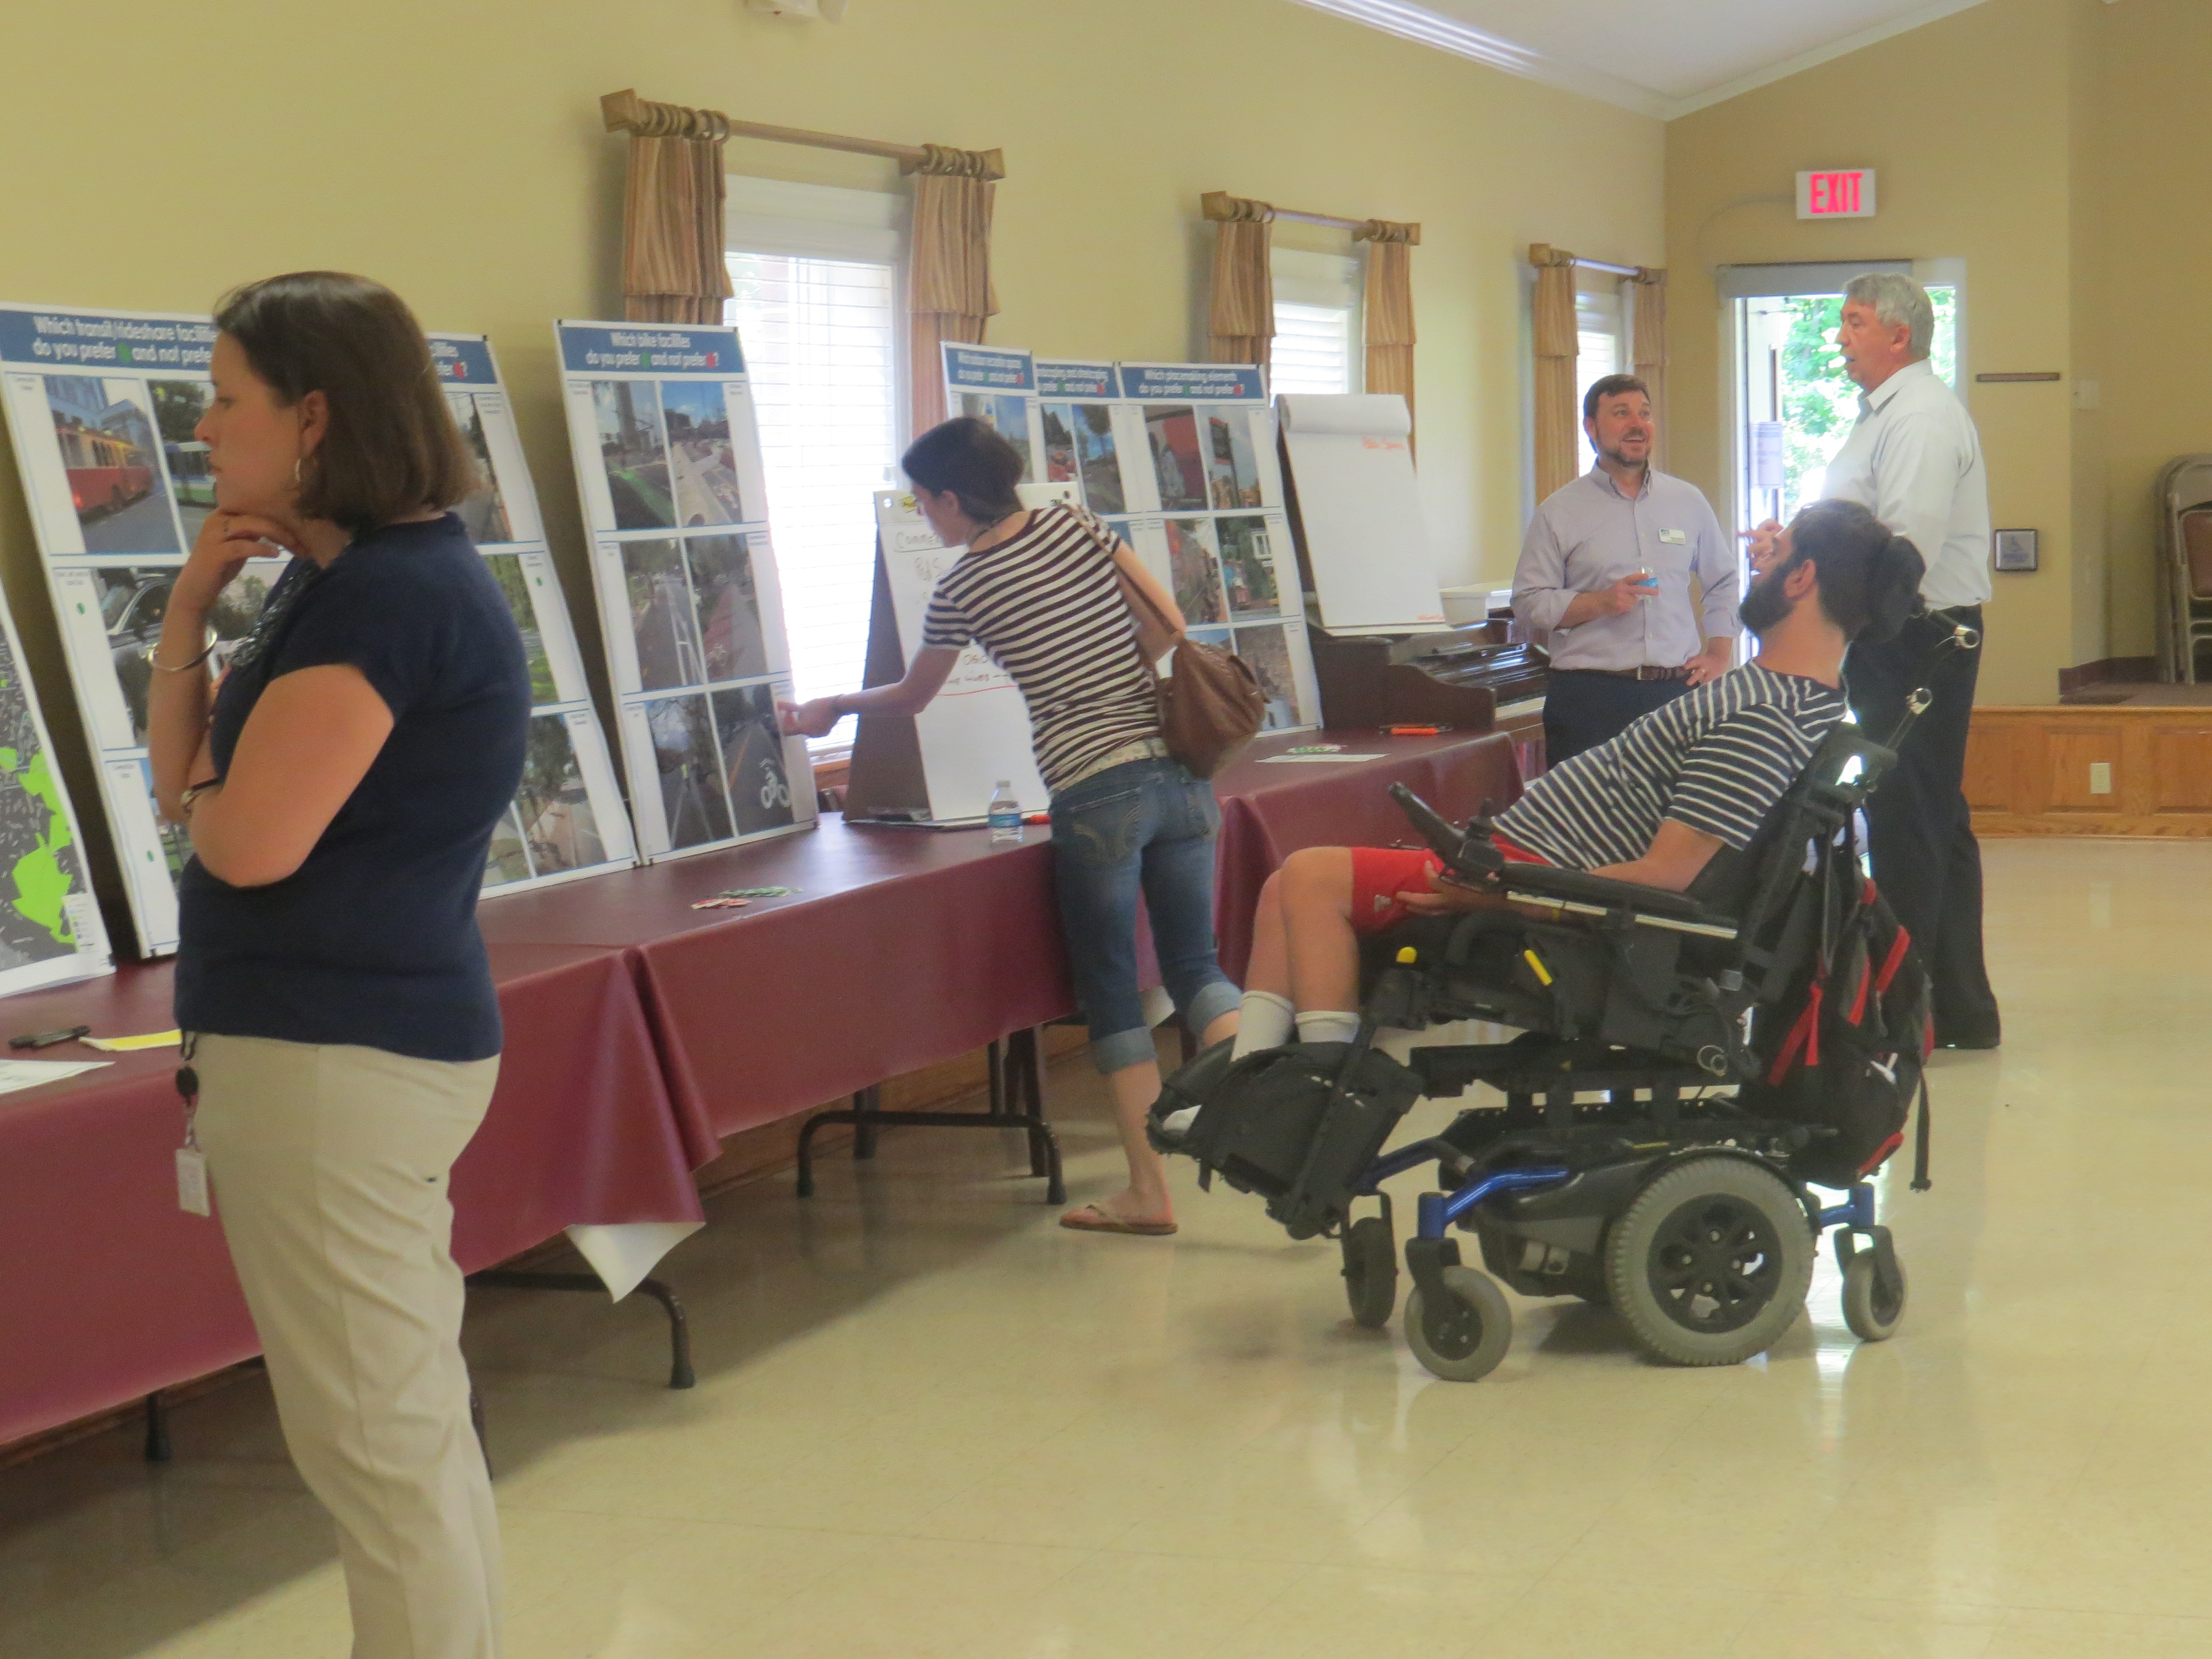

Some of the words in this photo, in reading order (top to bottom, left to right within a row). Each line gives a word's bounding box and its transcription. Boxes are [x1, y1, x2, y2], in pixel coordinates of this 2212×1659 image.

[1809, 172, 1863, 213] EXIT
[33, 316, 76, 335] Which
[175, 323, 217, 343] facilitie
[611, 332, 636, 347] Which
[637, 332, 658, 348] bike
[658, 333, 690, 349] facilities
[32, 337, 52, 357] do
[51, 343, 79, 361] you
[79, 341, 116, 363] prefer
[132, 344, 157, 362] and
[158, 345, 180, 363] not
[180, 346, 212, 366] prefe
[586, 349, 599, 365] do
[599, 353, 615, 368] you
[615, 351, 641, 369] prefer
[651, 352, 667, 367] and
[667, 351, 682, 367] not
